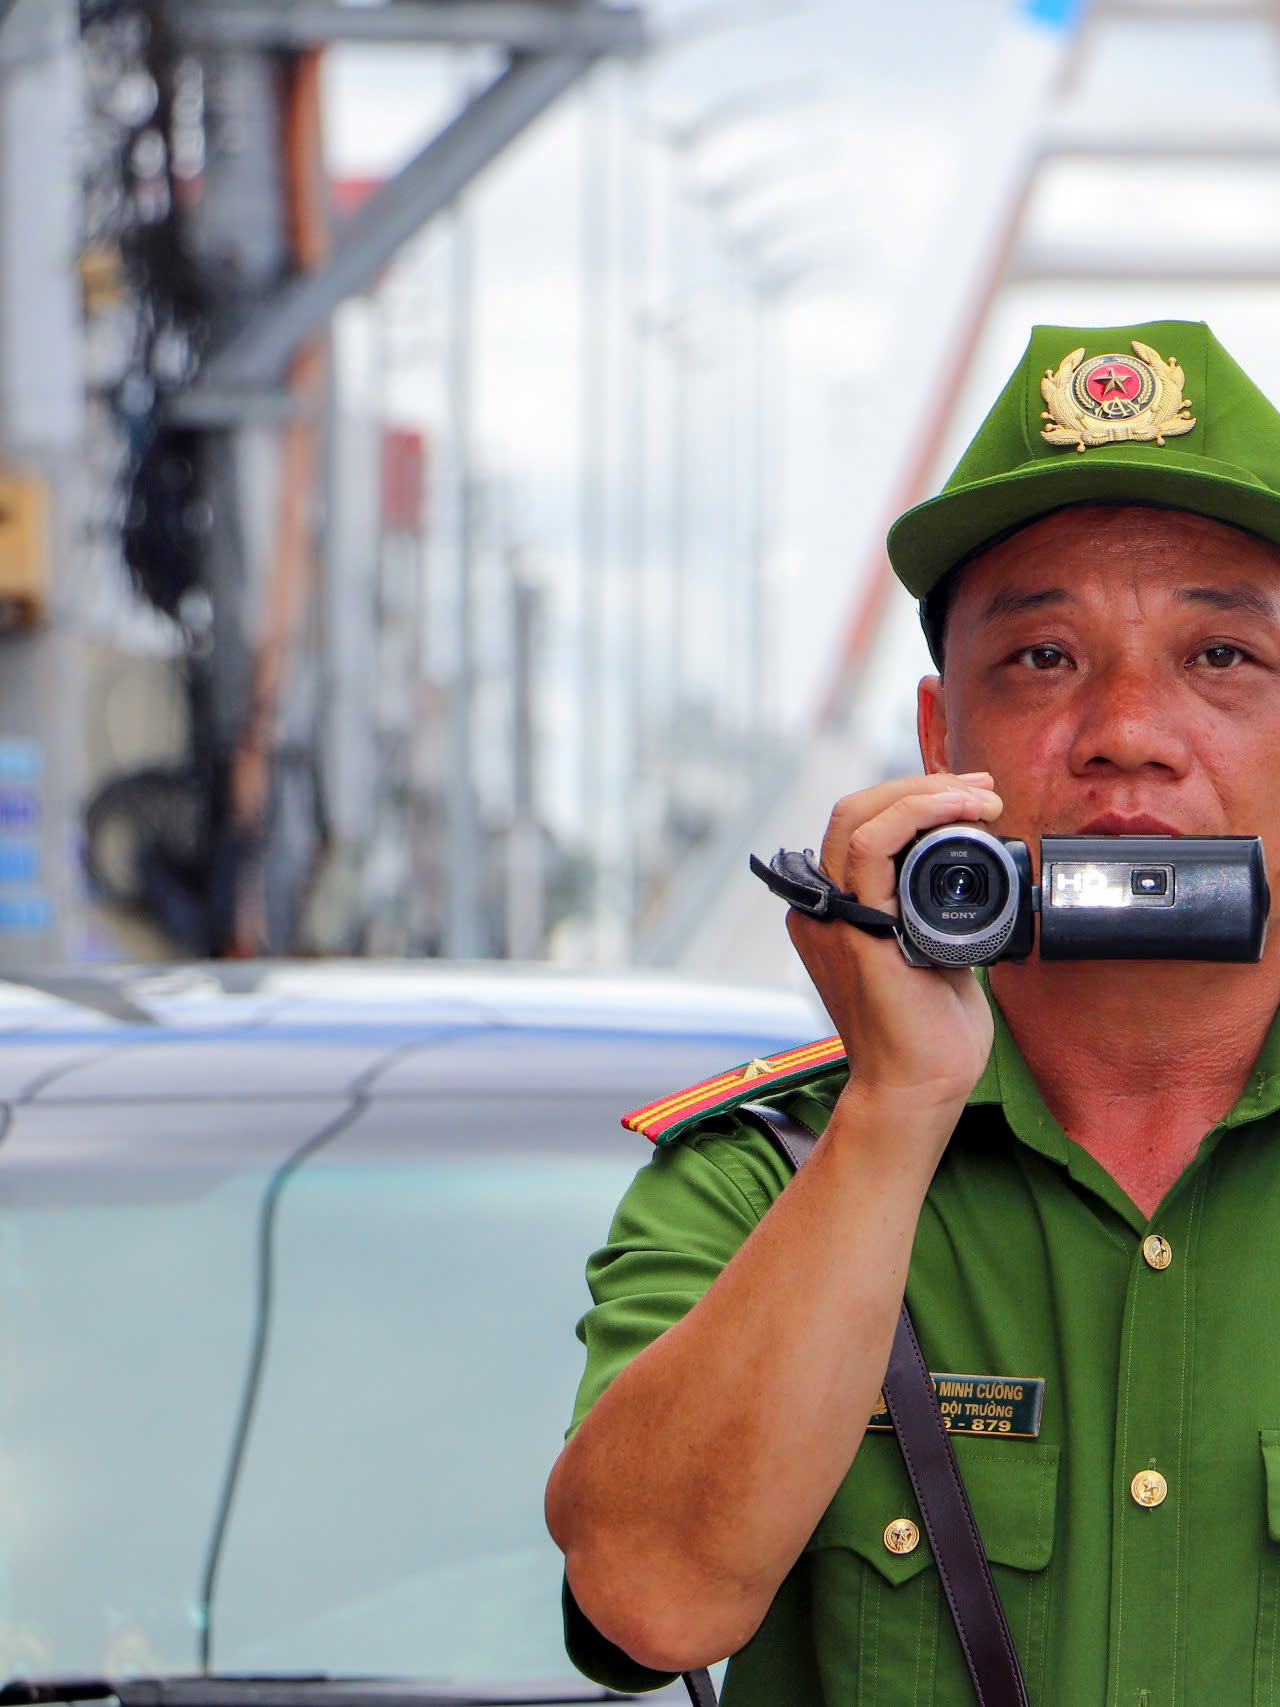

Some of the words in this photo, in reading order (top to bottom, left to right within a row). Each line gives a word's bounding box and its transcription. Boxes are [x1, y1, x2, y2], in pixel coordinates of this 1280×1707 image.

[941, 911, 977, 920] SONY
[939, 1382, 973, 1398] MINH
[976, 1380, 1023, 1401] CƯỜNG
[940, 1400, 962, 1418] ĐỘI
[964, 1401, 1013, 1417] TRƯỞNG
[971, 1419, 1011, 1432] 879
